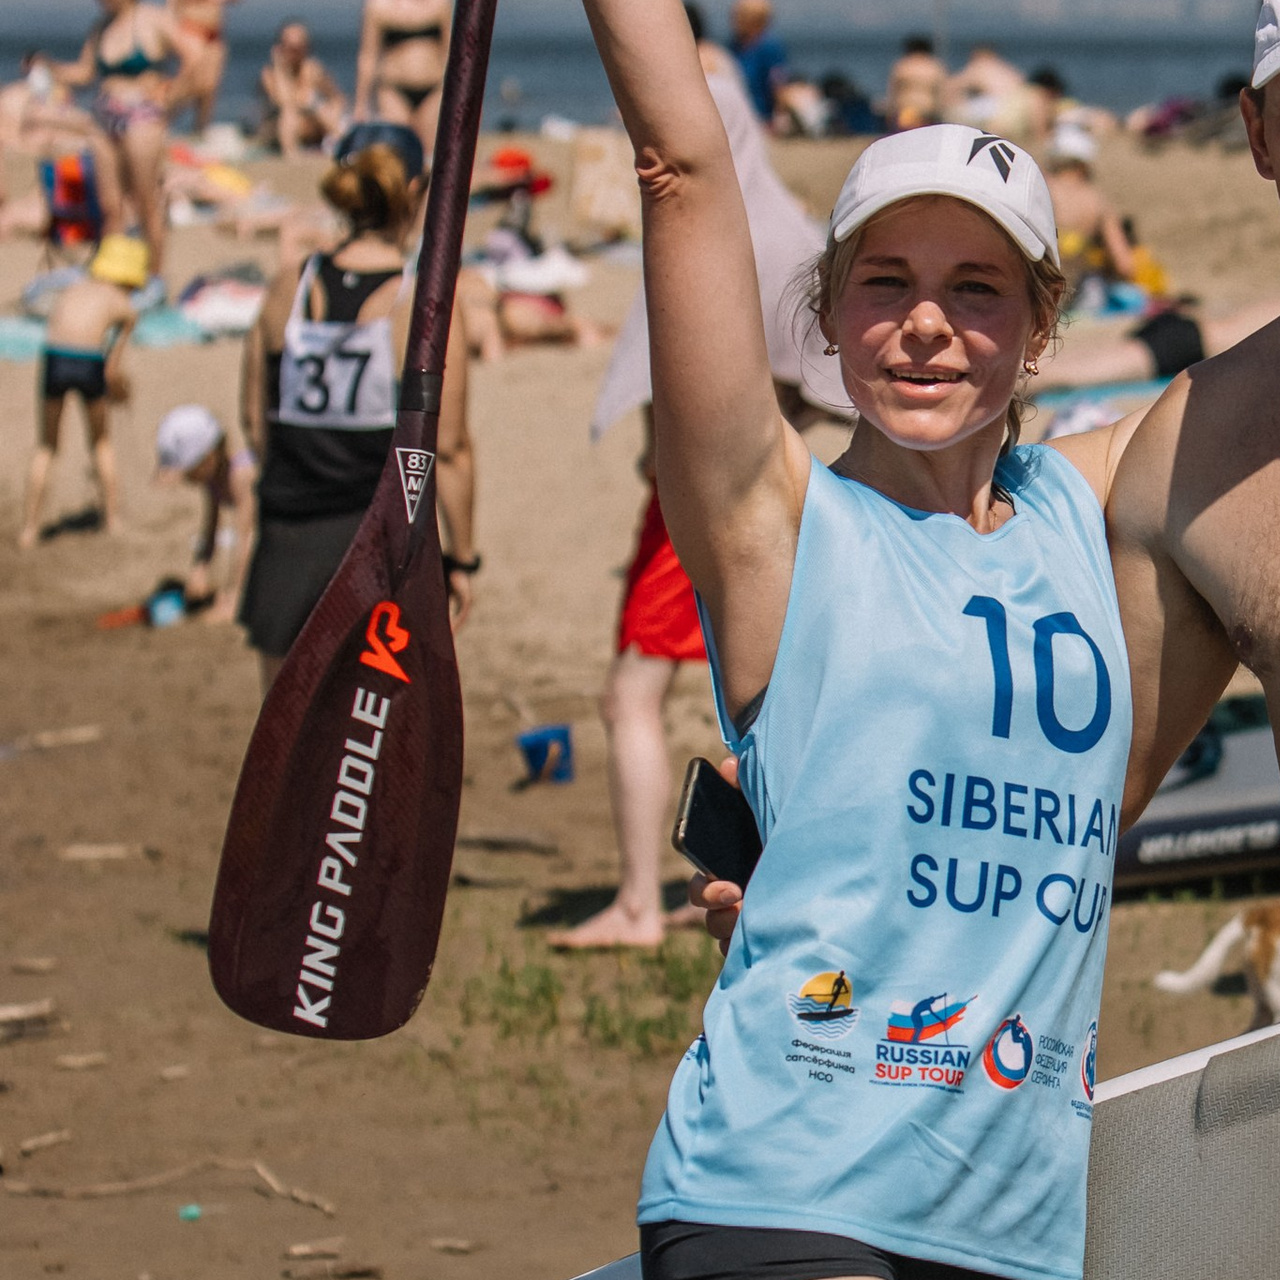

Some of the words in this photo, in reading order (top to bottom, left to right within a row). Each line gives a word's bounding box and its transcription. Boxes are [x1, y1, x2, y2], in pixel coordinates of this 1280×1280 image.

[295, 349, 371, 416] 37
[408, 453, 428, 470] 83
[407, 476, 423, 491] M
[962, 595, 1111, 753] 10
[317, 687, 392, 897] PADDLE
[906, 853, 1023, 918] SUP
[293, 901, 347, 1029] KING
[791, 1038, 851, 1059] Федерация
[876, 1044, 971, 1069] RUSSIAN
[808, 1069, 834, 1084] НСО
[875, 1063, 912, 1081] SUP
[918, 1067, 965, 1087] TOUR
